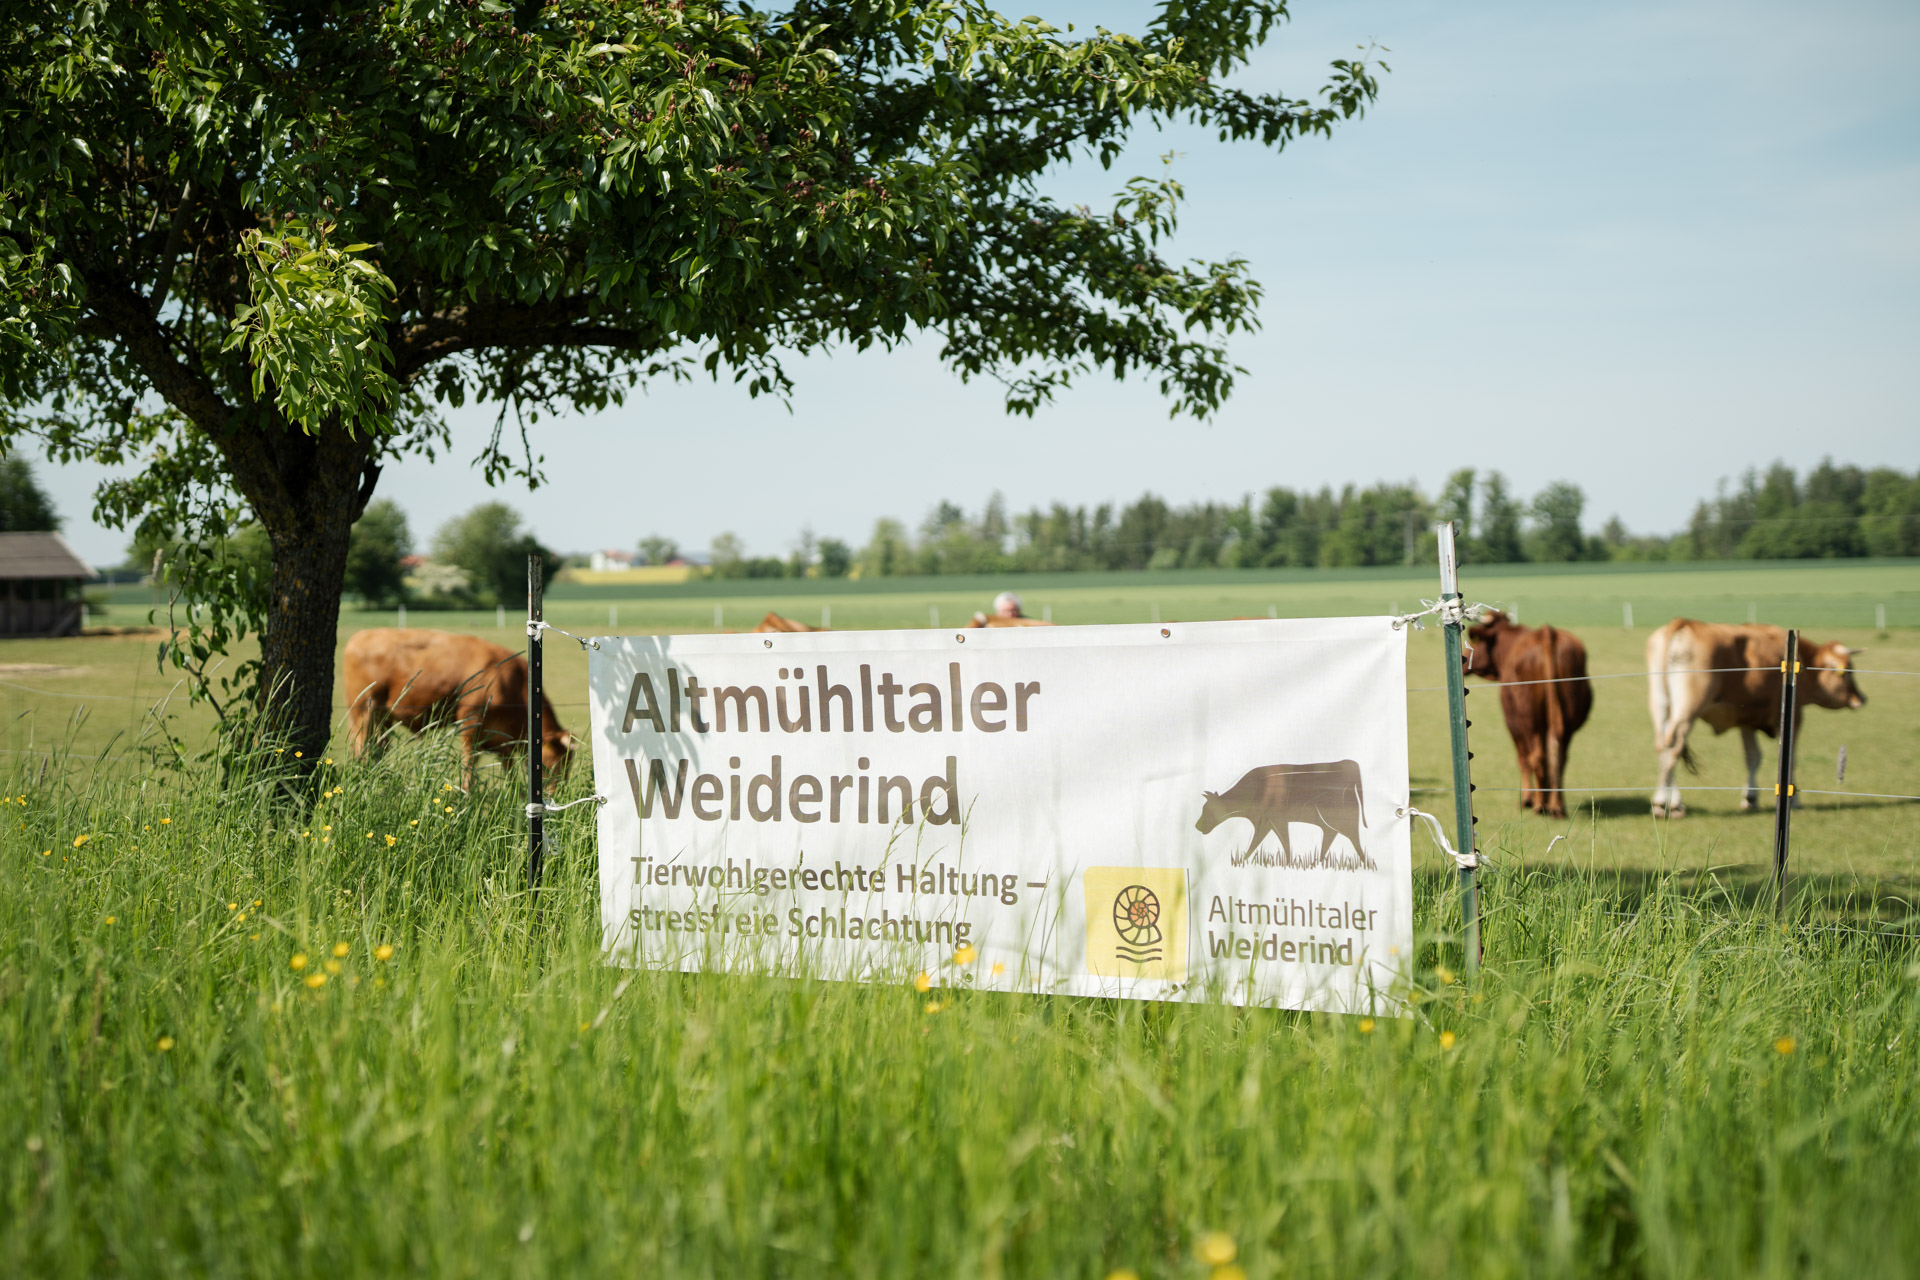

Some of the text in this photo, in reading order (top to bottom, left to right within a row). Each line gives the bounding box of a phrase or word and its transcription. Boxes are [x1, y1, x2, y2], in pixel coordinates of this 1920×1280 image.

[622, 662, 1041, 734] Altmühltaler
[624, 755, 961, 826] Weiderind
[631, 856, 886, 896] Tierwohlgerechte
[897, 863, 1018, 905] Haltung
[629, 904, 972, 950] stressfreie Schlachtung
[1208, 895, 1378, 931] Altmühltaler
[1208, 930, 1353, 966] Weiderind
